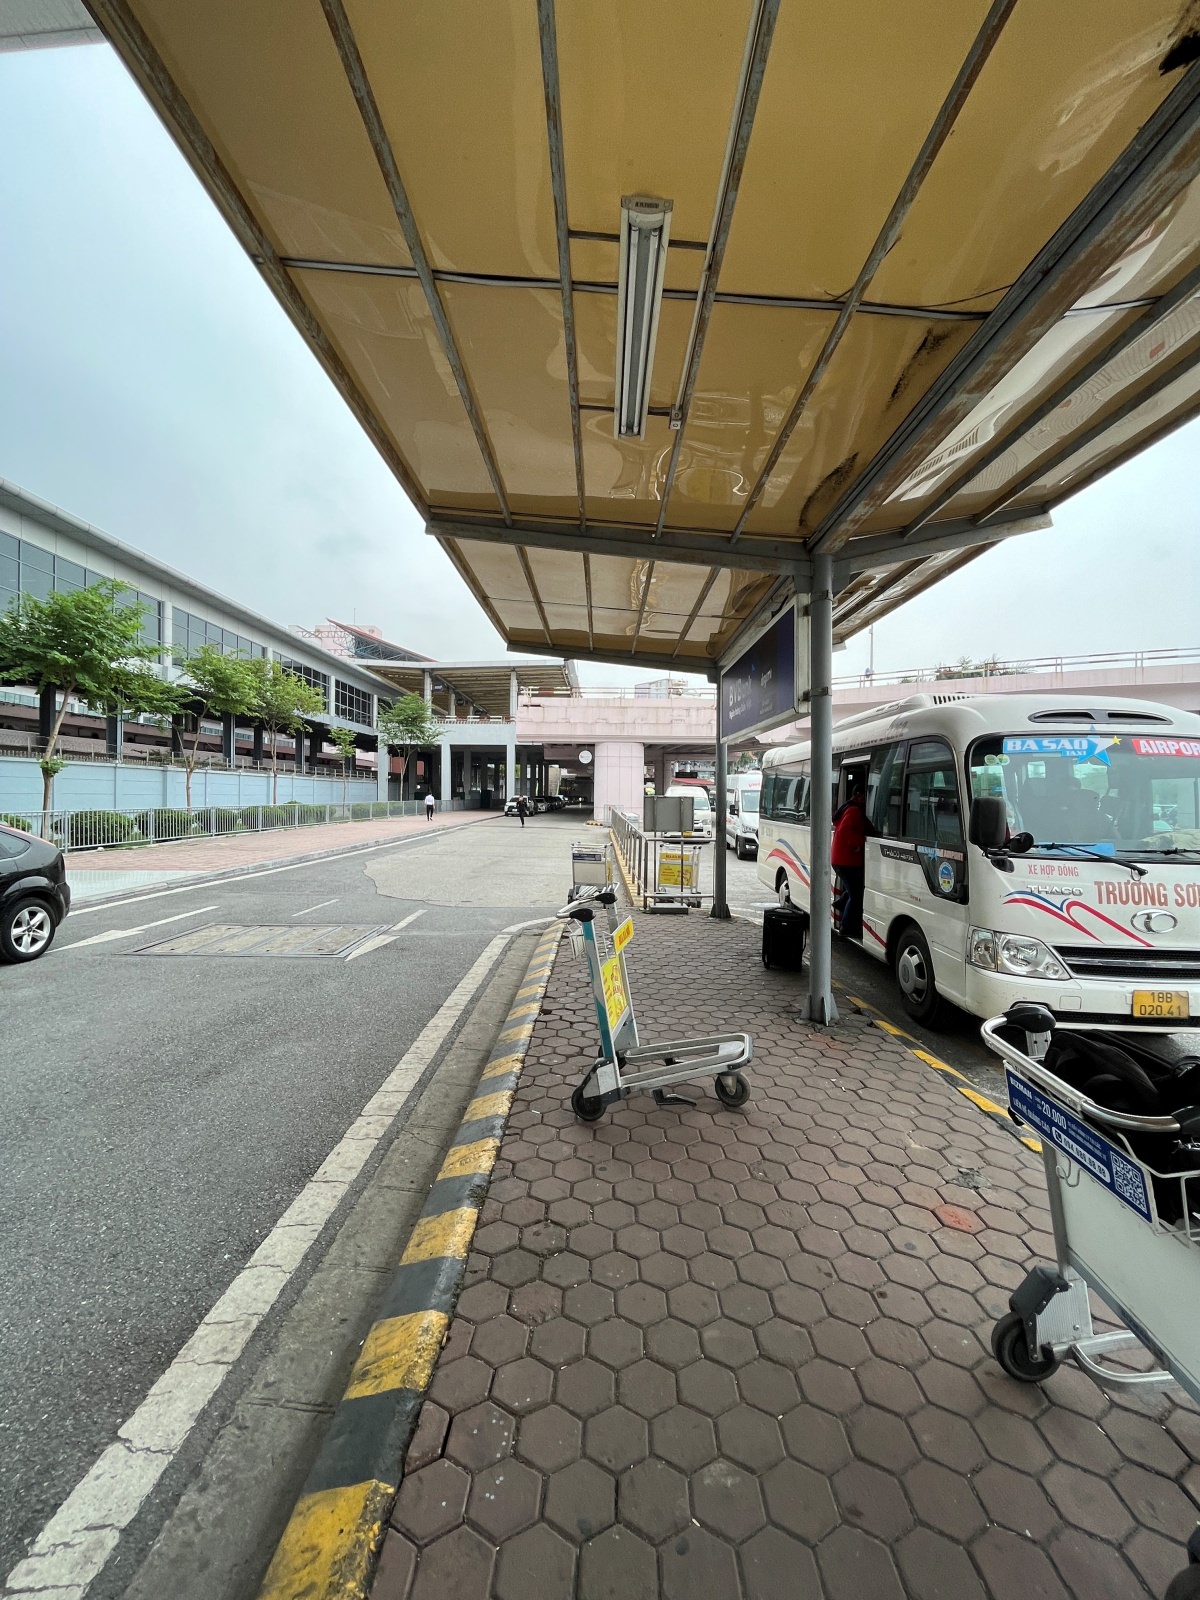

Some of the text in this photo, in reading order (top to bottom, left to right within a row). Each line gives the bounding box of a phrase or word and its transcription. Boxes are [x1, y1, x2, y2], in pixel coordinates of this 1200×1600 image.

[1007, 739, 1088, 751] BA SAO
[1028, 864, 1038, 875] XE
[1027, 885, 1084, 896] THACO
[1151, 991, 1172, 1003] 18B
[1140, 1004, 1181, 1016] 020.41
